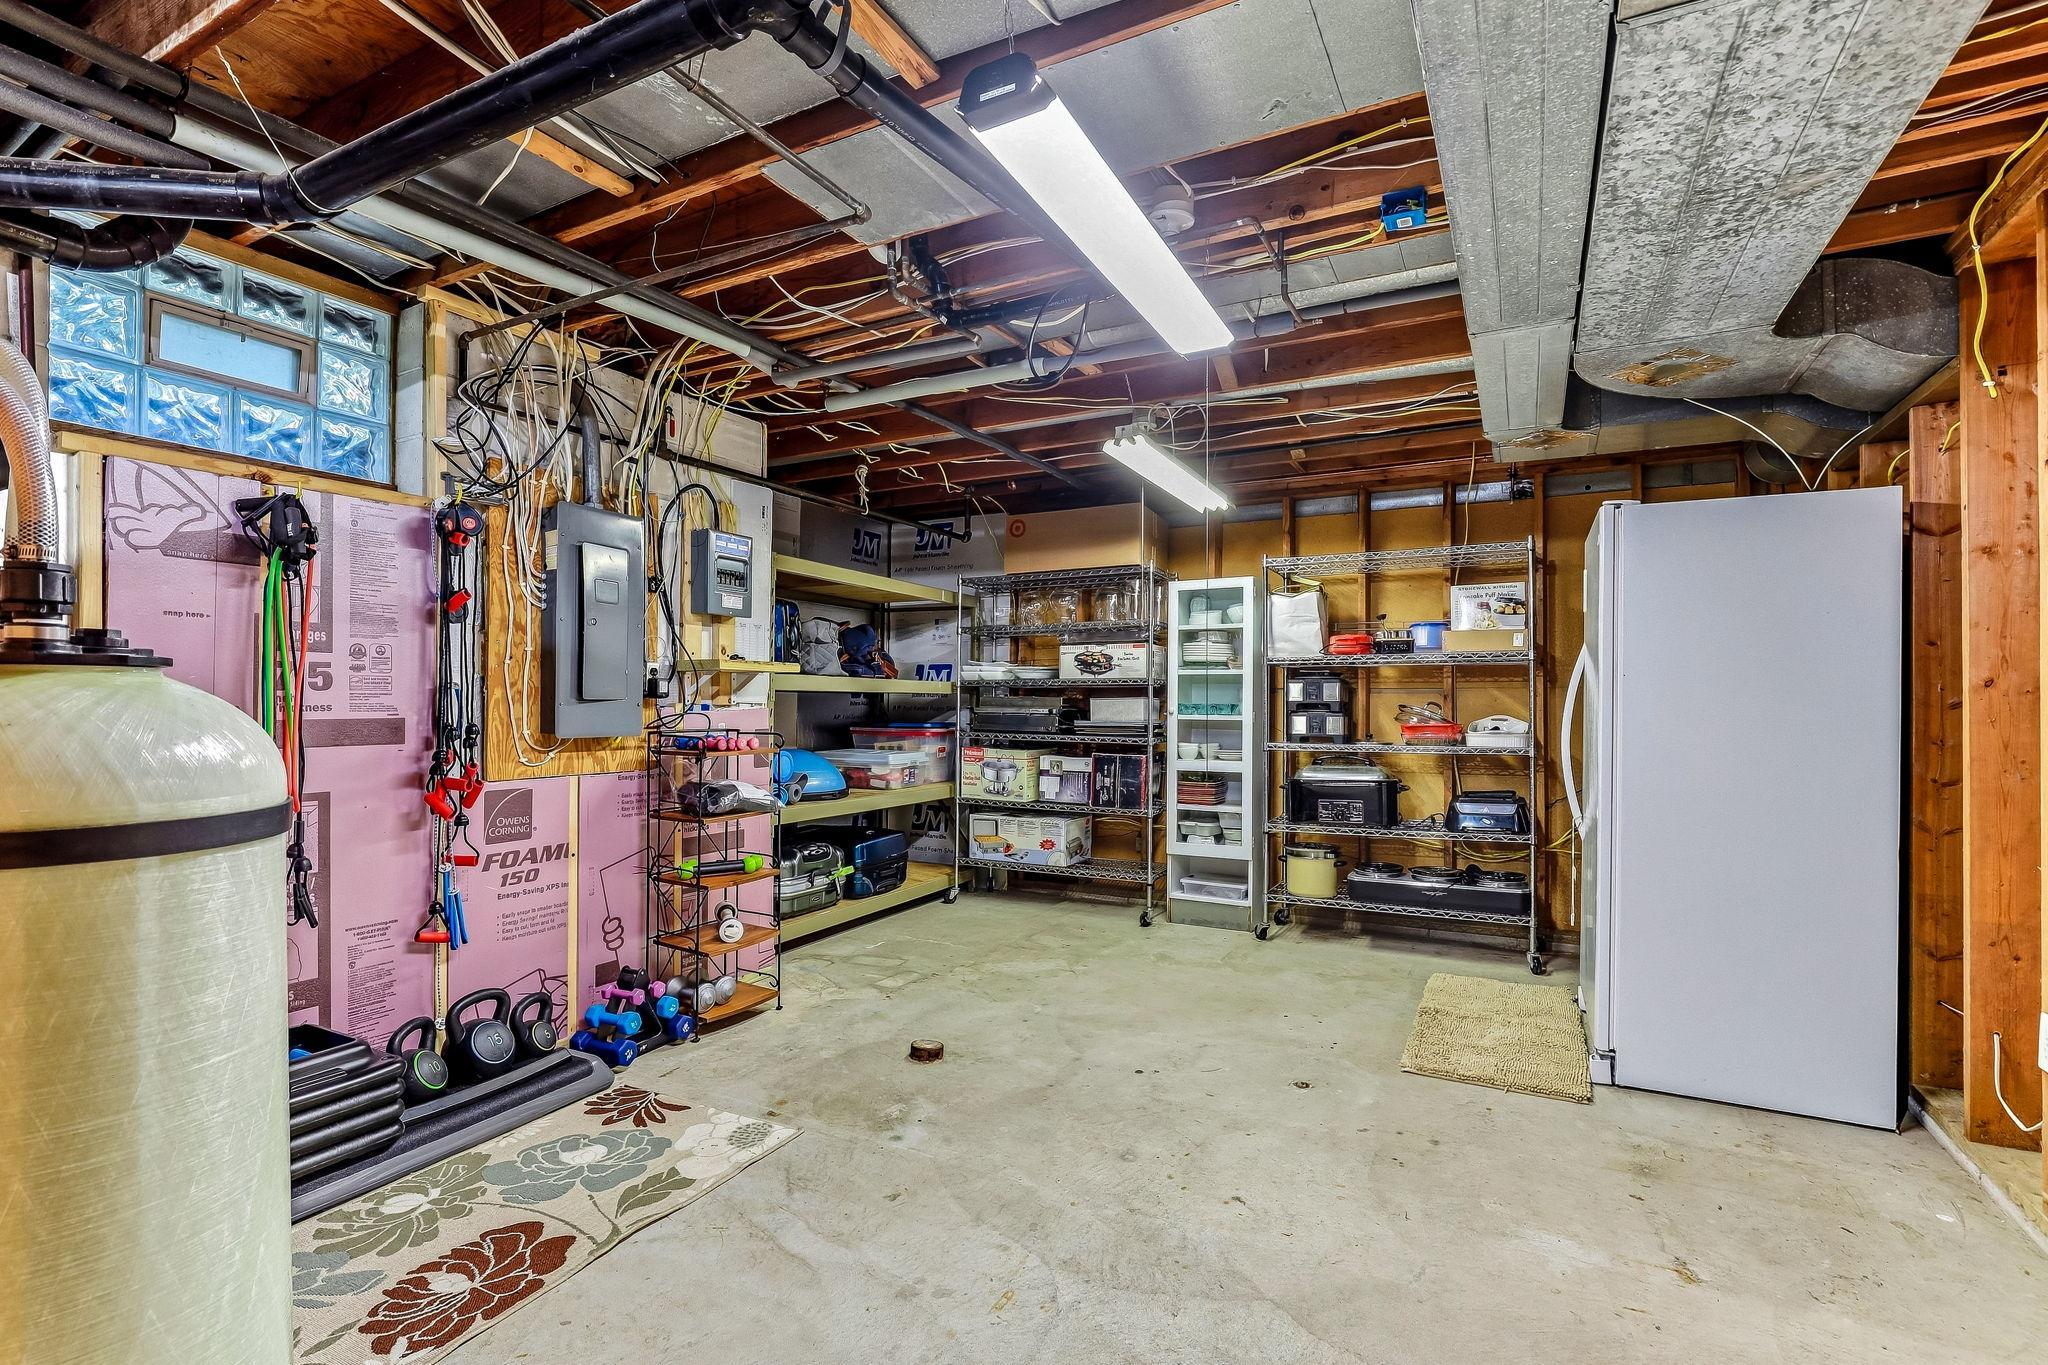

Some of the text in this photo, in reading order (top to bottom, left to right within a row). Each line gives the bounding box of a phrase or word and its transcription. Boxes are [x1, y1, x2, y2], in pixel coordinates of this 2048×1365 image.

[163, 610, 184, 618] snap
[496, 815, 530, 827] OWENS
[488, 825, 530, 837] CORNING
[500, 868, 540, 888] 150
[497, 886, 545, 900] Energy-Saving
[545, 882, 560, 891] XPS
[487, 1033, 503, 1047] 15
[544, 1029, 551, 1039] 5
[428, 1060, 441, 1073] 10
